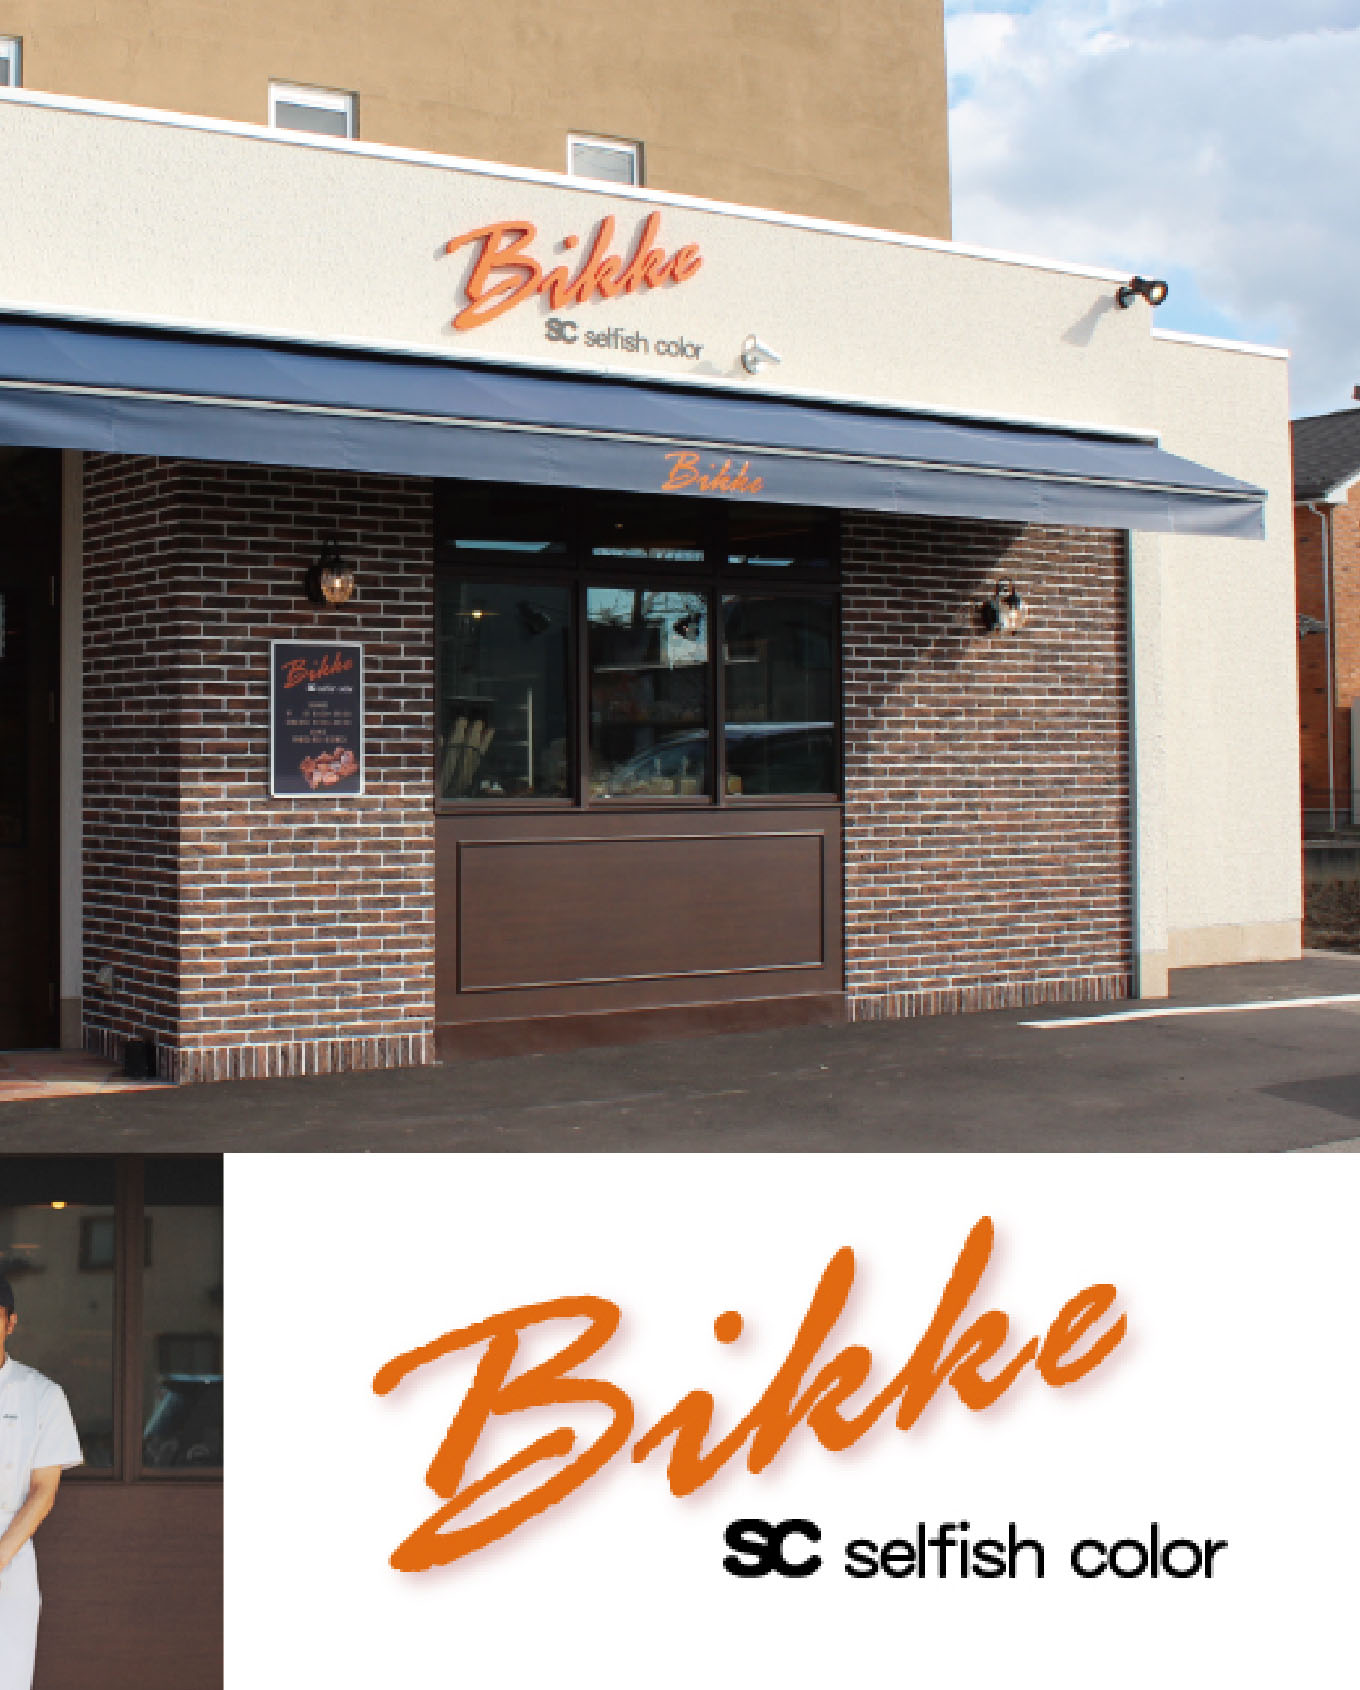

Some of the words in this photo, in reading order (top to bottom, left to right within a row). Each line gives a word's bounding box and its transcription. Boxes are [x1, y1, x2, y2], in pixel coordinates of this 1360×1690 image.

[444, 211, 702, 330] Bikke
[545, 318, 579, 344] SC
[584, 327, 649, 355] selfish
[654, 336, 704, 360] color
[661, 451, 764, 493] Bikke
[281, 652, 353, 688] Bikke
